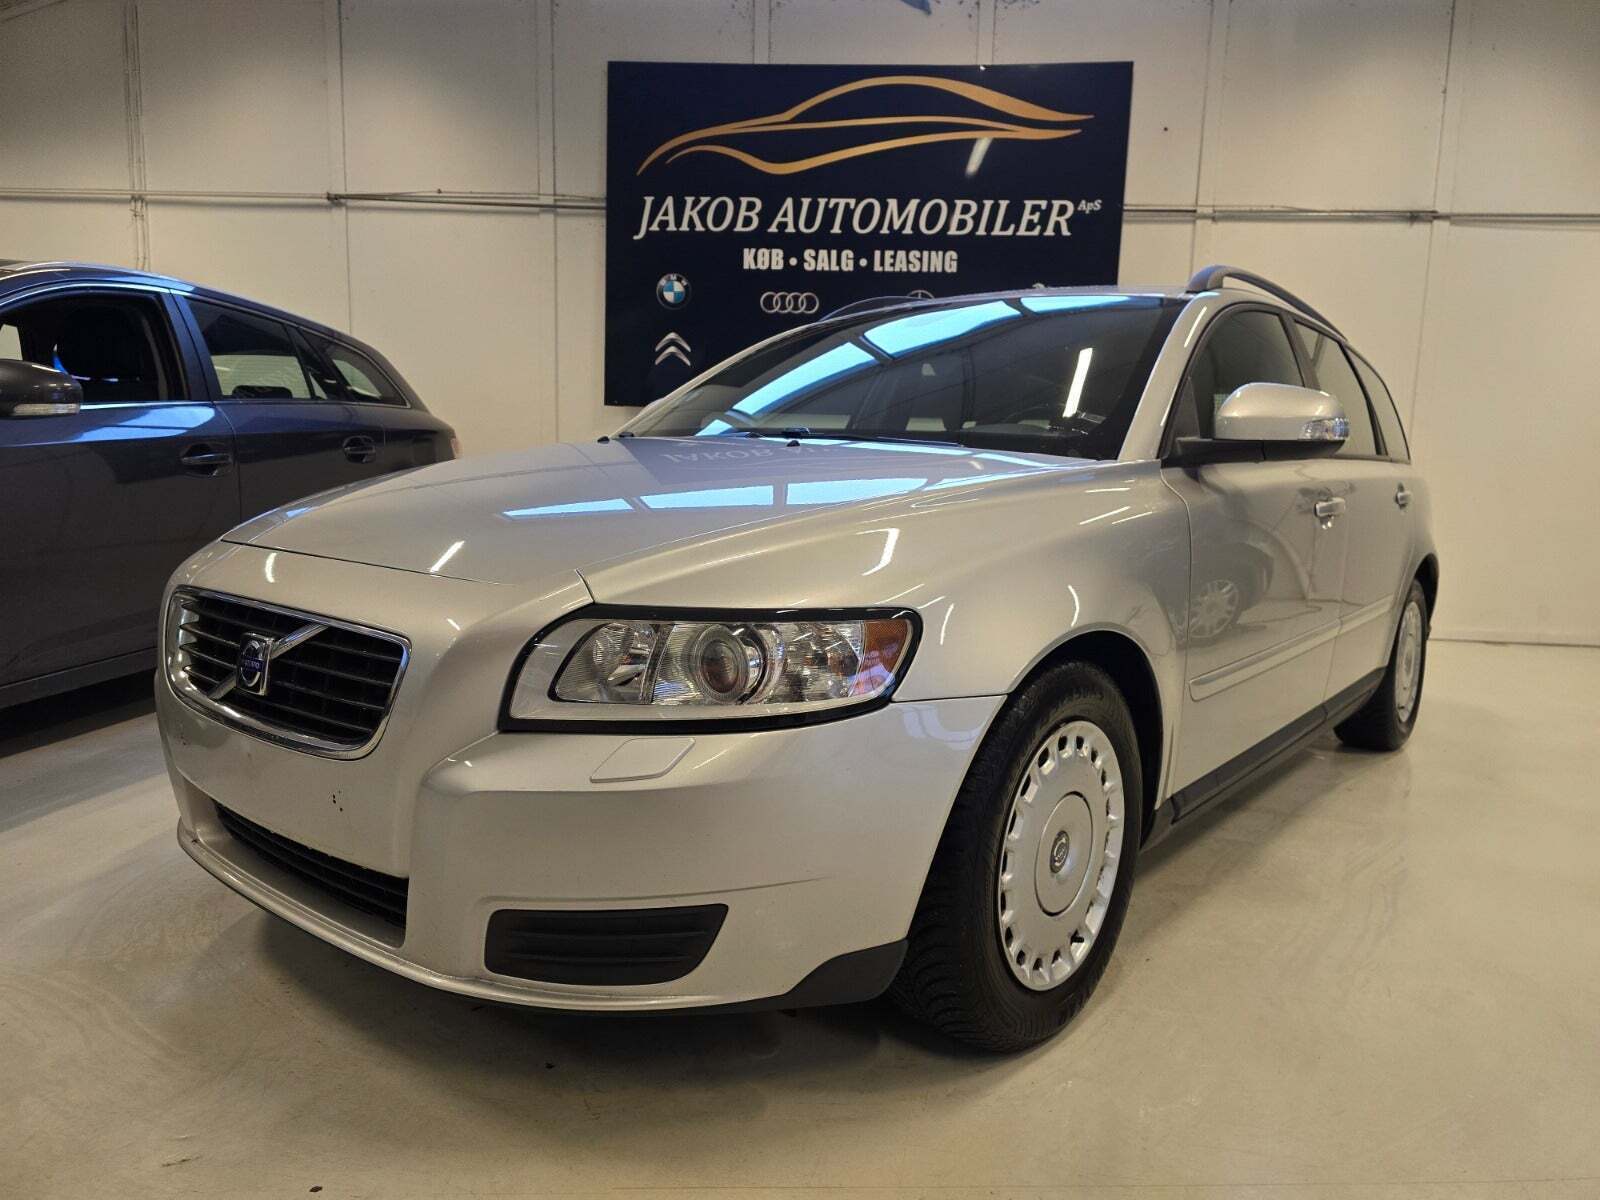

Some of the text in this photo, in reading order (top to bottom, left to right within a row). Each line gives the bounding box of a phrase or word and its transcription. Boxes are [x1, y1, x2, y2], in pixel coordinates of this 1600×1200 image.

[633, 196, 1102, 240] JAKOB AUTOMOBILER ApS
[742, 248, 959, 273] KØB SALG LEASING
